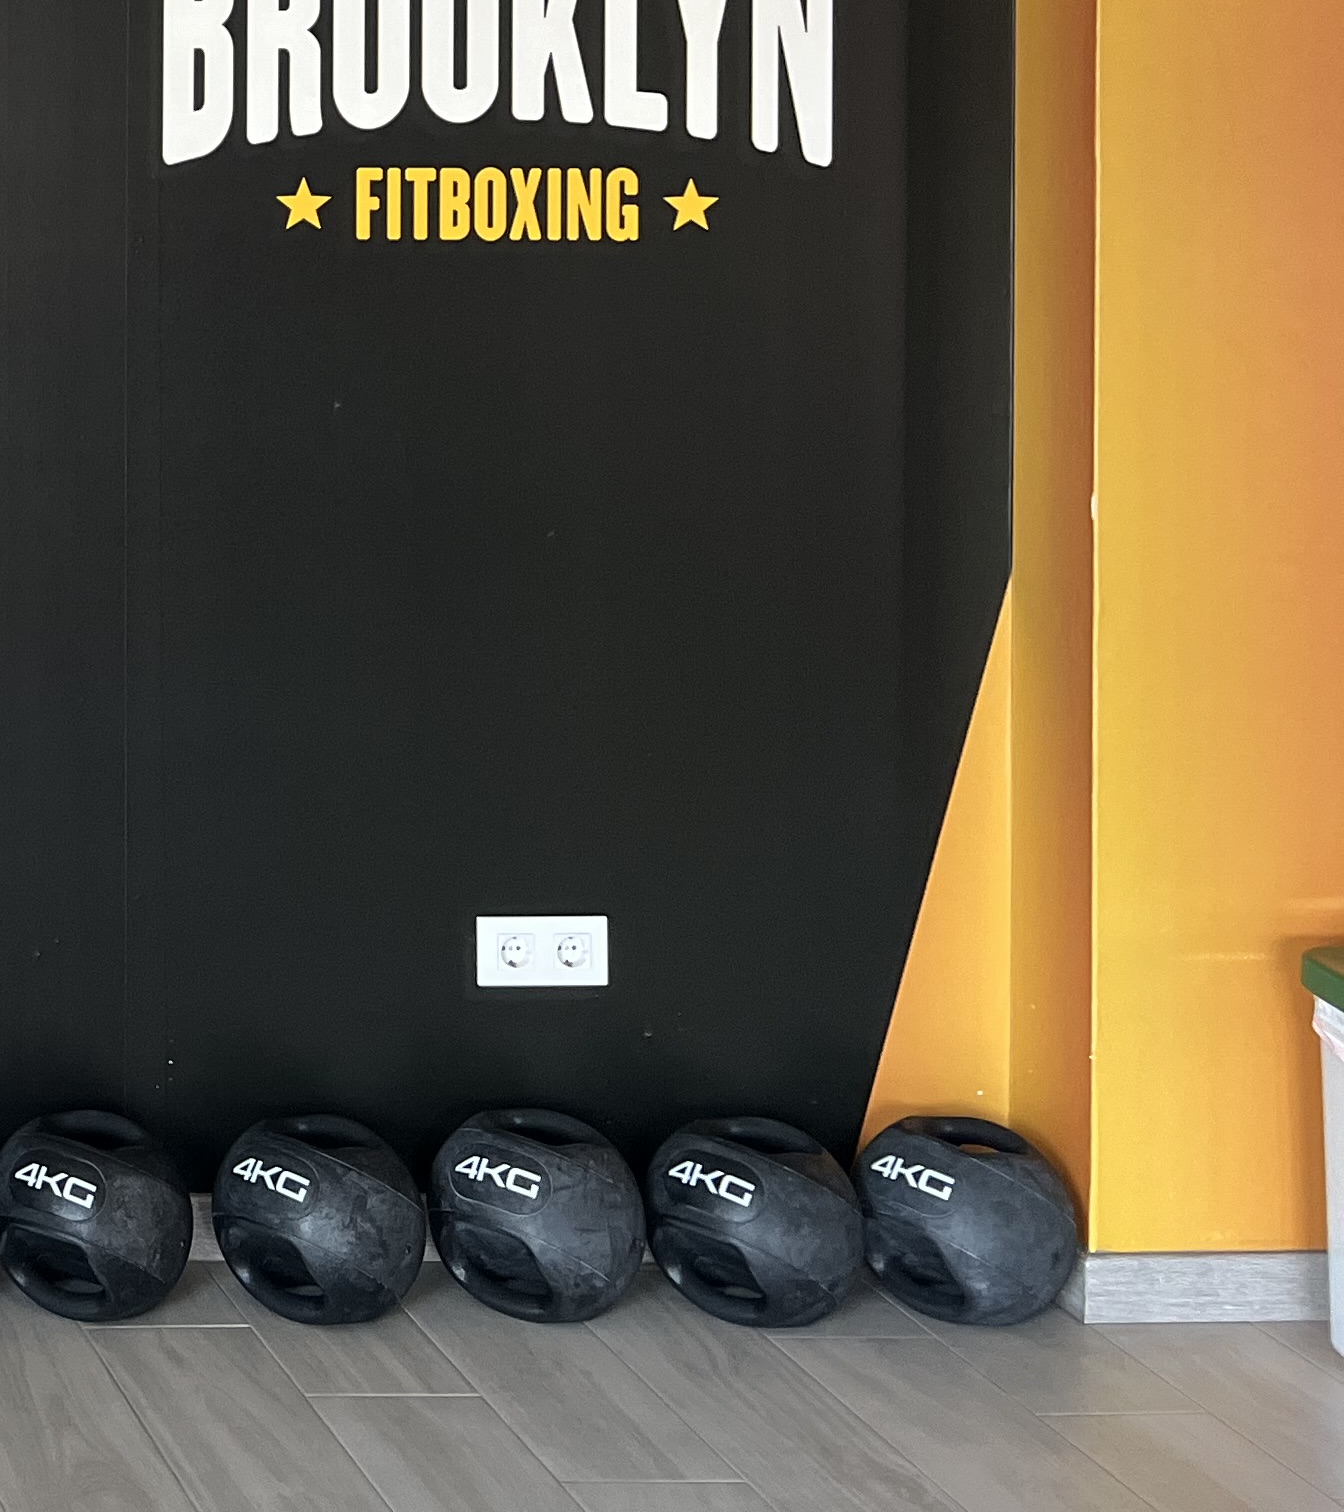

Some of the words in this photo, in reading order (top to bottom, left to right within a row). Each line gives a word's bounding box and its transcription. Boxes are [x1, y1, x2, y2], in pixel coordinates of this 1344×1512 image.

[356, 167, 639, 241] FITBOXING
[14, 1163, 97, 1210] 4KG
[232, 1157, 311, 1203] 4KG
[454, 1155, 542, 1200] 4KG
[668, 1160, 756, 1208] 4KG
[871, 1155, 956, 1201] 4KG
